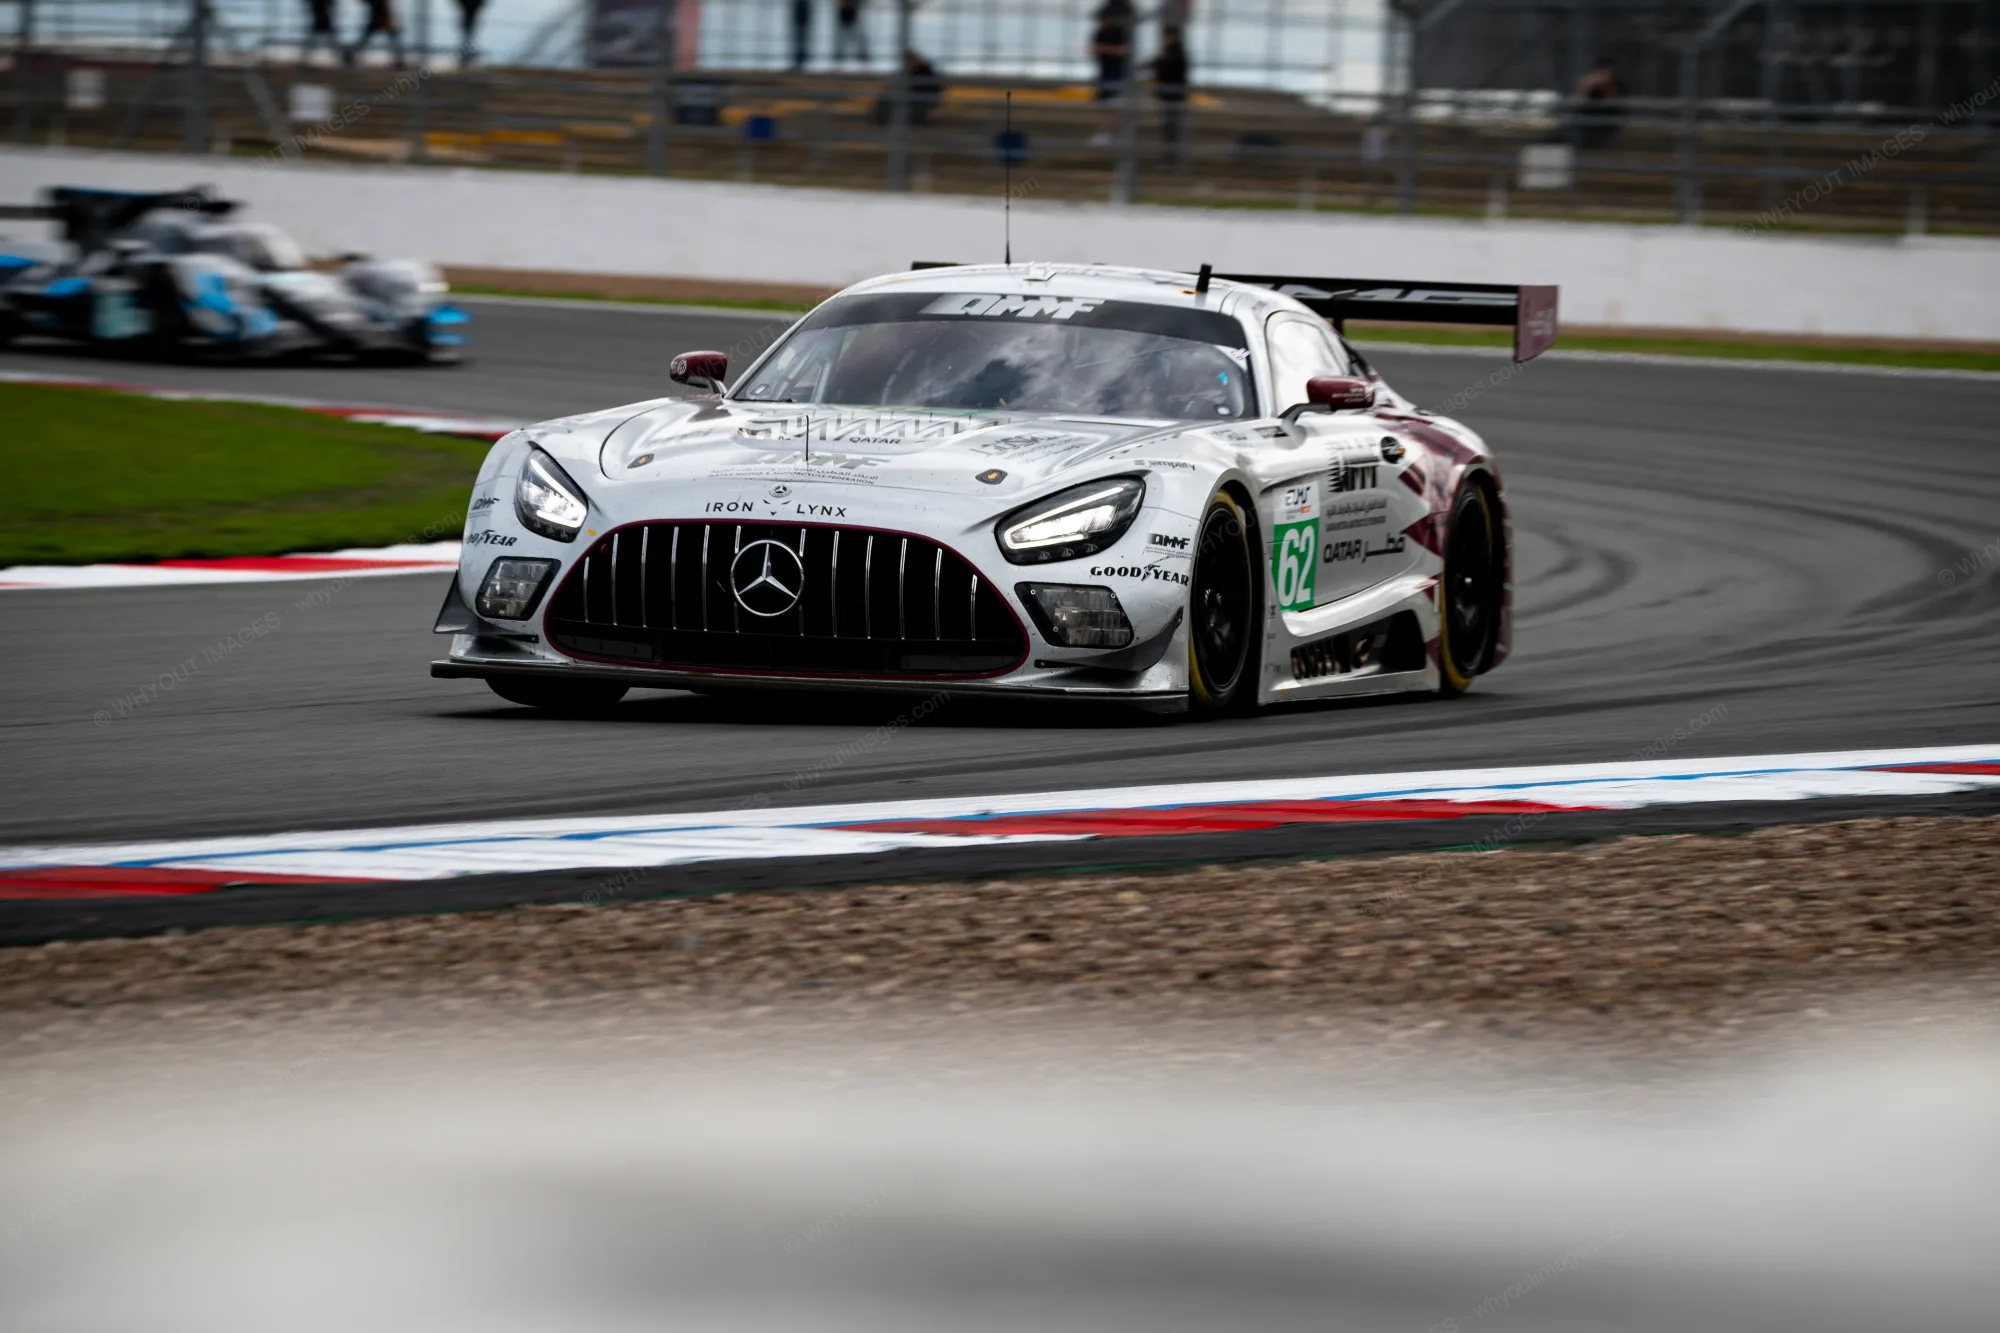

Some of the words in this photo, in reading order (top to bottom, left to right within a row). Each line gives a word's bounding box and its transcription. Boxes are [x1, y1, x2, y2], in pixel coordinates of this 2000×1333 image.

[918, 293, 1106, 319] QMMF
[849, 435, 902, 446] QATAR
[705, 501, 754, 513] IRON
[796, 503, 847, 518] LYNX
[1148, 533, 1190, 550] QMMF
[1323, 539, 1362, 563] QATAR
[1278, 525, 1315, 607] 62
